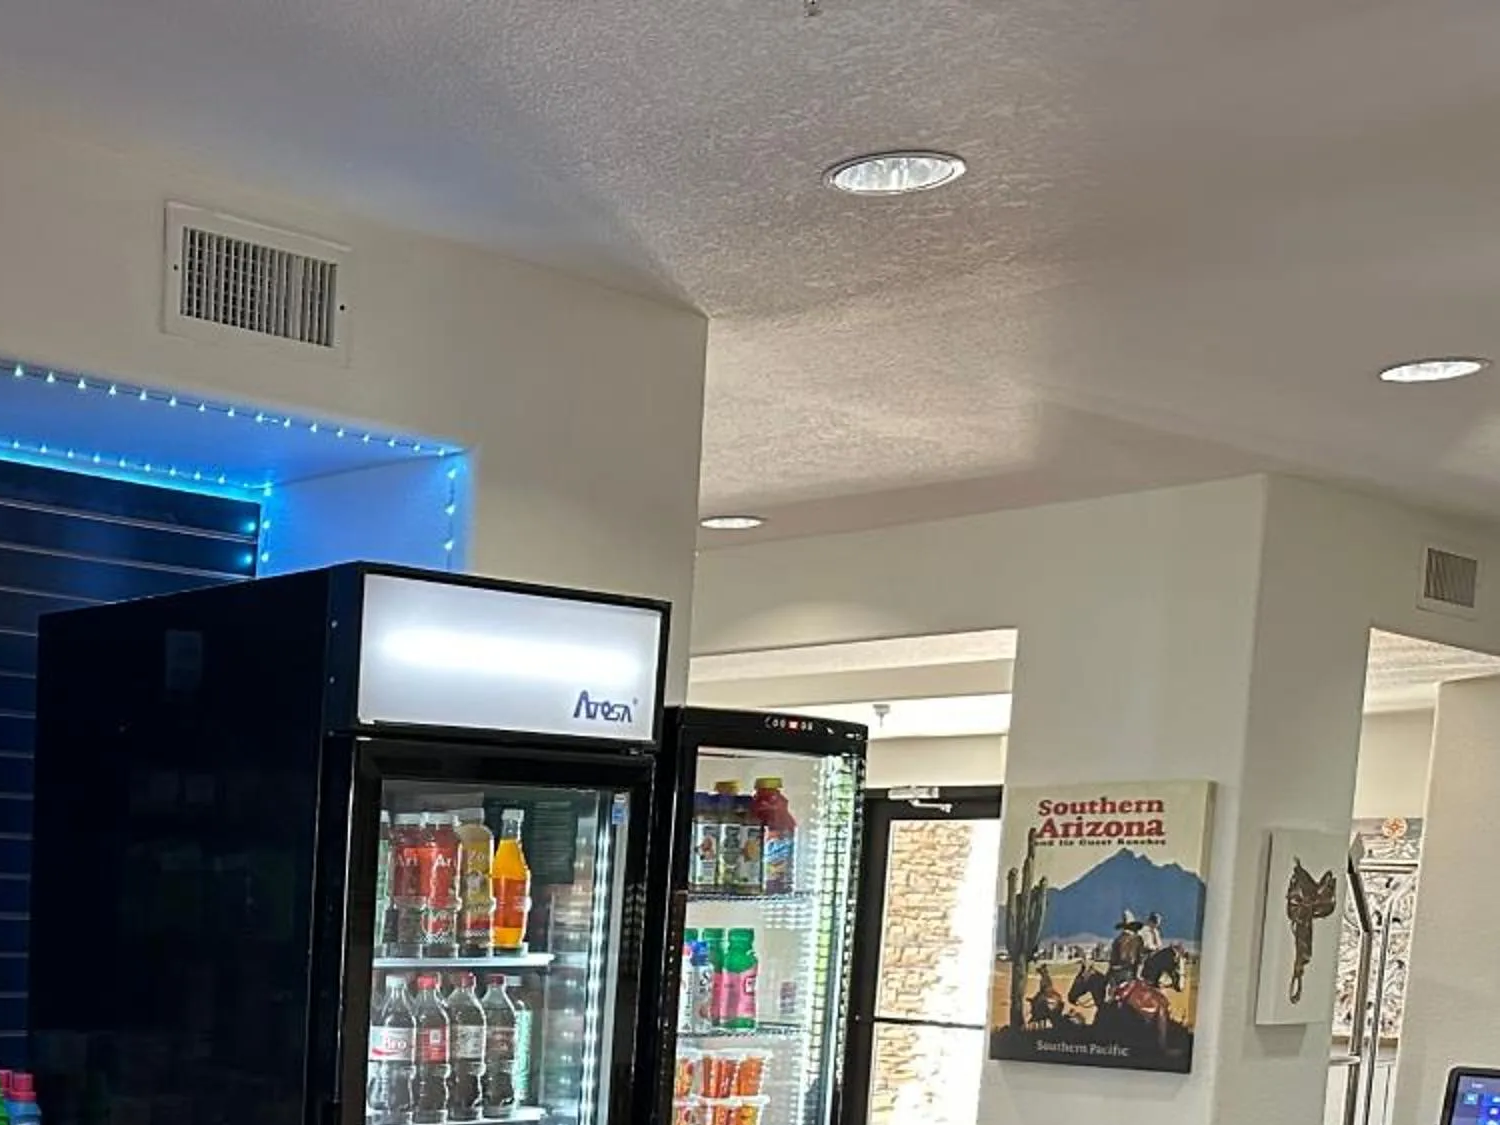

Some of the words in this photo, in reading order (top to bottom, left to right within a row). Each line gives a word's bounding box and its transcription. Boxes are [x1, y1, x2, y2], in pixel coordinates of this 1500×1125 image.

[1038, 797, 1165, 816] Southern
[1036, 816, 1165, 838] Arizona
[1036, 1040, 1087, 1053] Southern
[1089, 1043, 1130, 1056] Pacific
